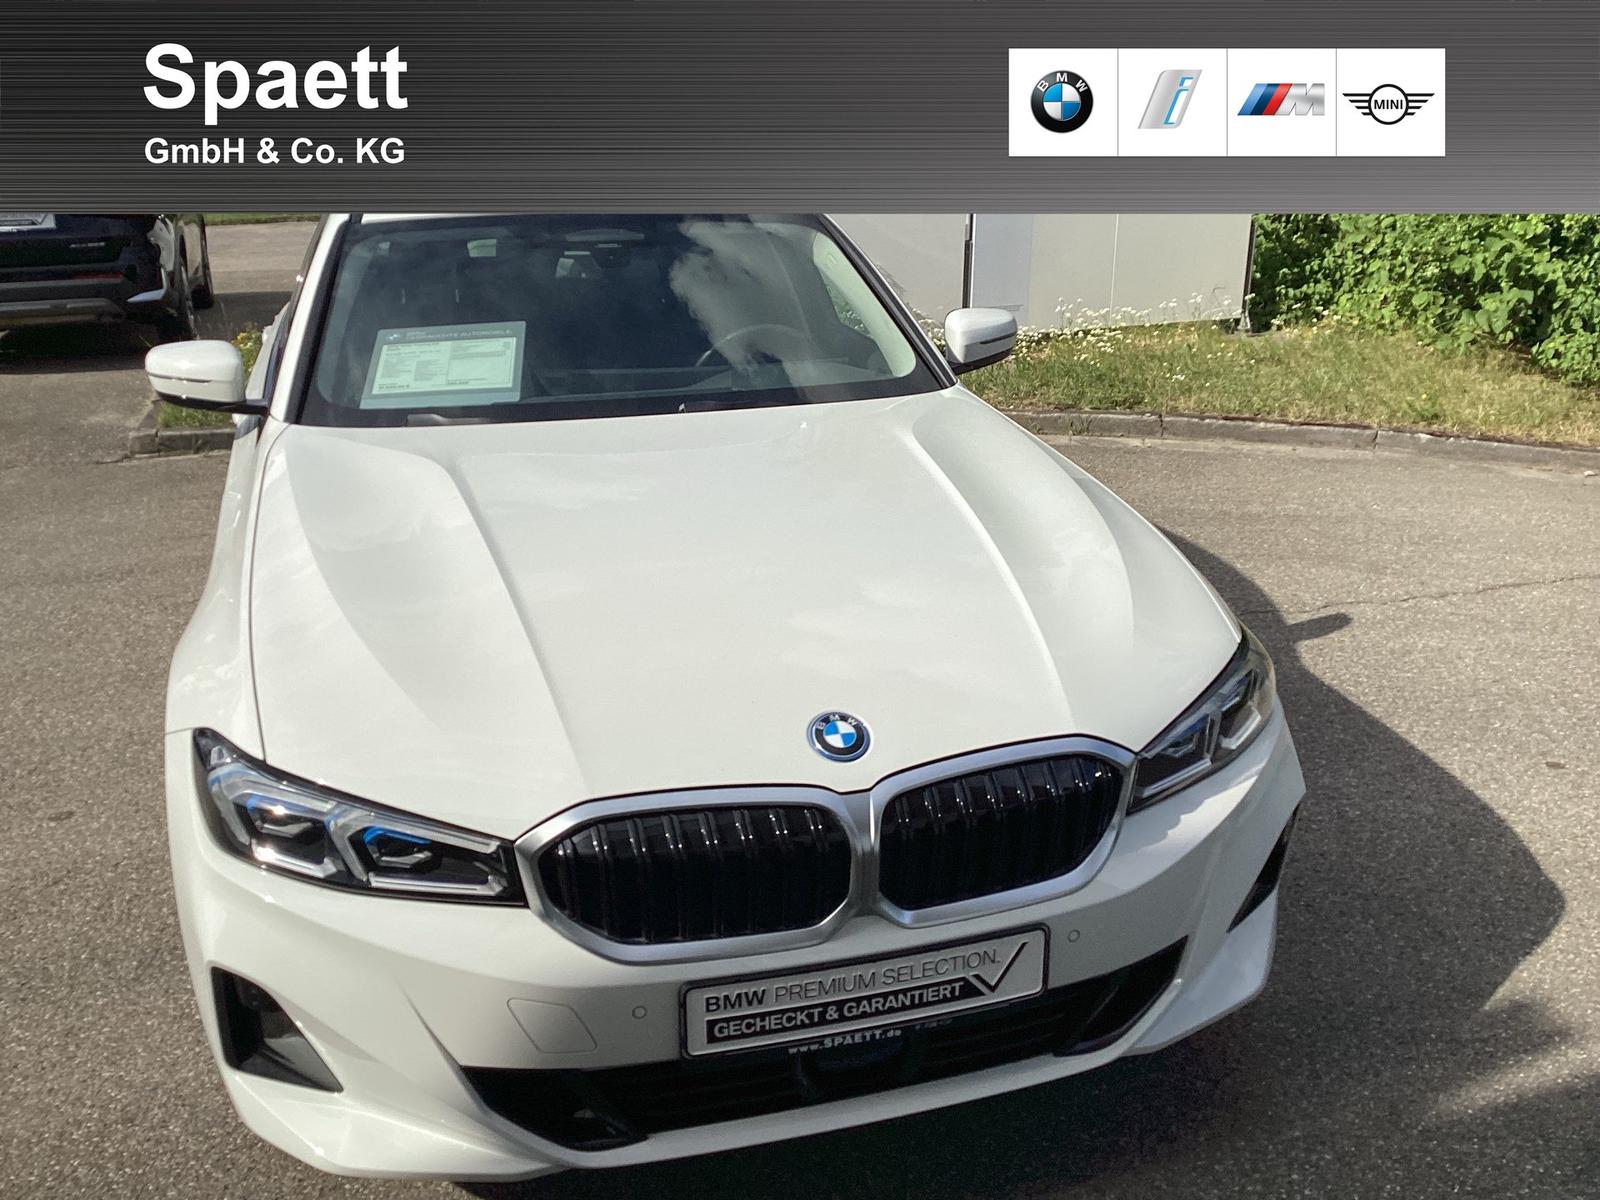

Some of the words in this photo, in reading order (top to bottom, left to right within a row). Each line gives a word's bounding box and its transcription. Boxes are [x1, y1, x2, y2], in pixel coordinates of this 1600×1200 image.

[817, 714, 858, 730] BMW
[705, 989, 766, 1013] BMW
[774, 973, 876, 1002] PREMIUM
[713, 1007, 823, 1038] GECHECKT
[825, 1004, 840, 1020] &
[843, 982, 964, 1017] GARANTIERT
[787, 1028, 903, 1055] www.SPAETT.de
